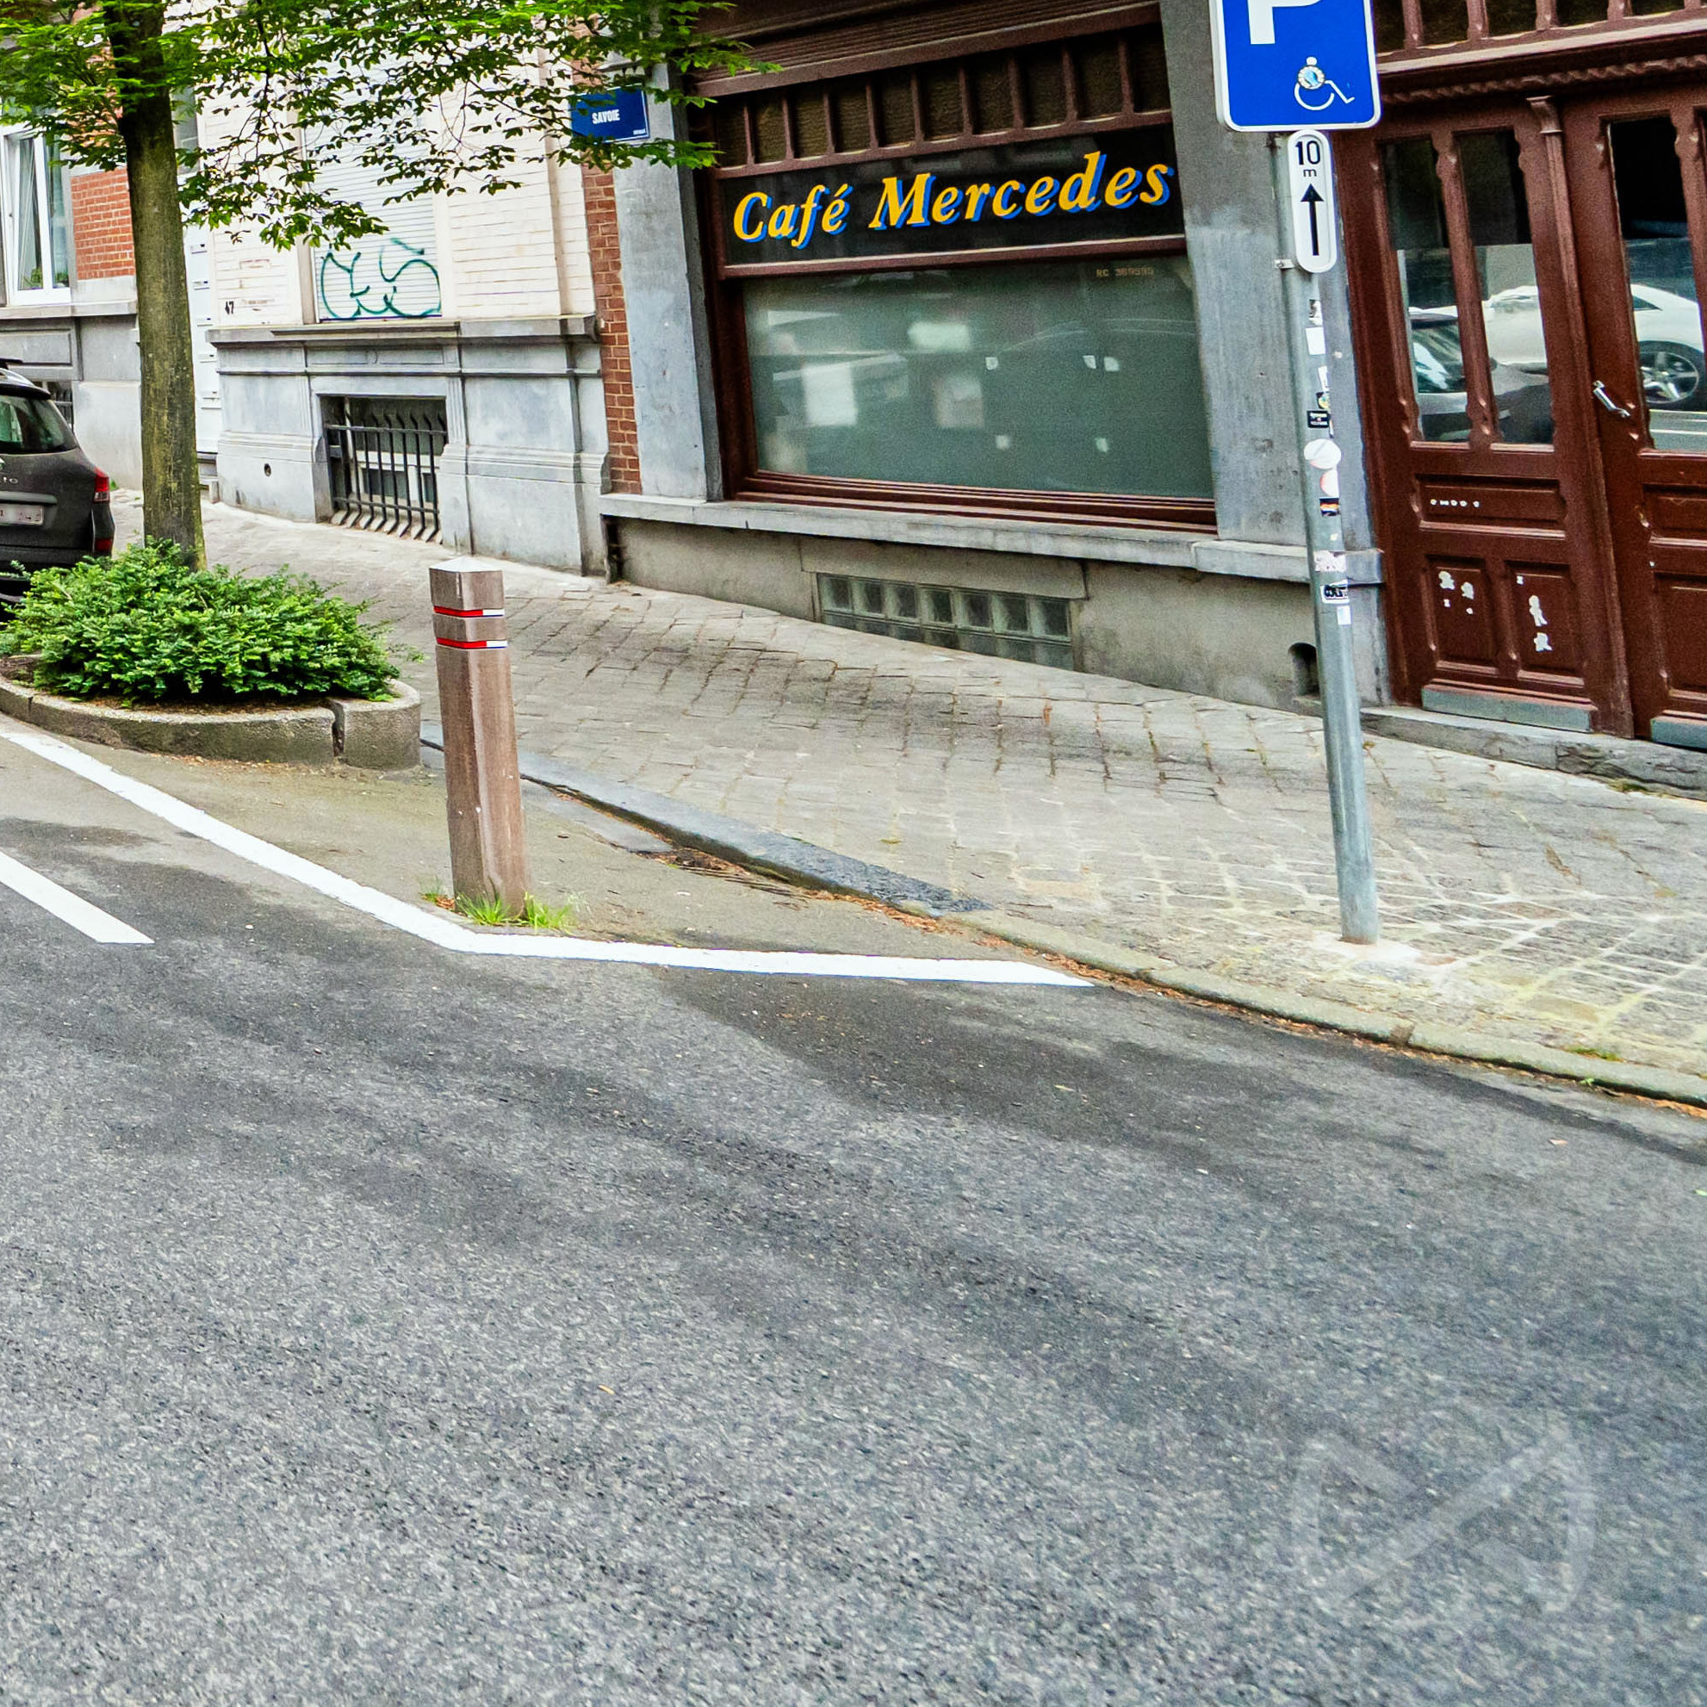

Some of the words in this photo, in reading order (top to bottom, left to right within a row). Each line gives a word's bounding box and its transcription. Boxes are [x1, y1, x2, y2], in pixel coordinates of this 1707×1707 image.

[591, 109, 621, 125] SAVOIE
[1295, 140, 1321, 165] 10
[1303, 169, 1317, 177] m
[733, 182, 854, 249] Café
[868, 151, 1175, 230] Mercedes
